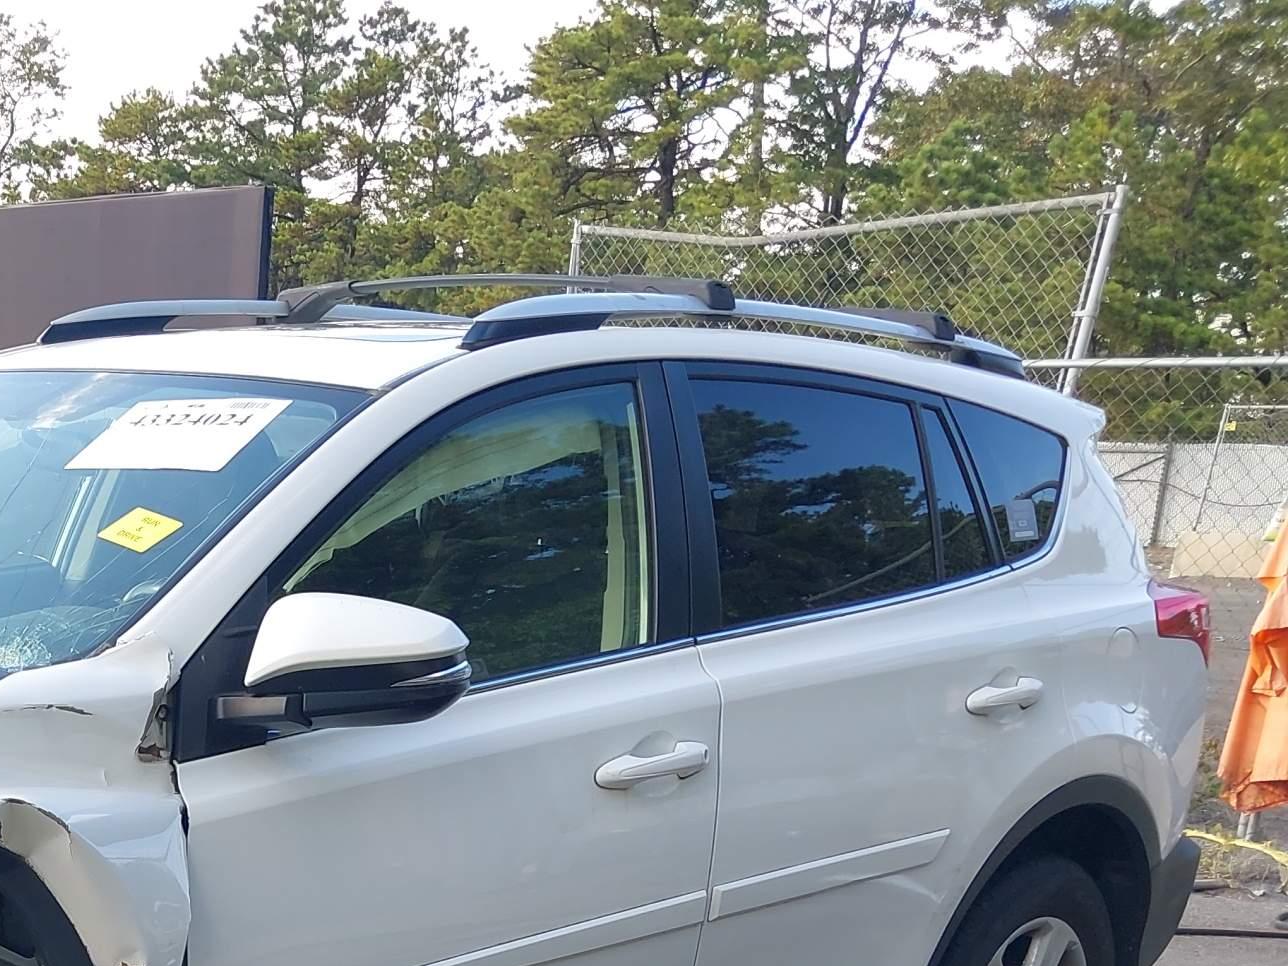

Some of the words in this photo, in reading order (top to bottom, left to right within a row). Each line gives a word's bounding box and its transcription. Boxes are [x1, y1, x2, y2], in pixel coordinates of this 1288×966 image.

[129, 412, 255, 427] 43324024
[140, 516, 161, 528] RUN
[116, 528, 144, 543] DRIVE
